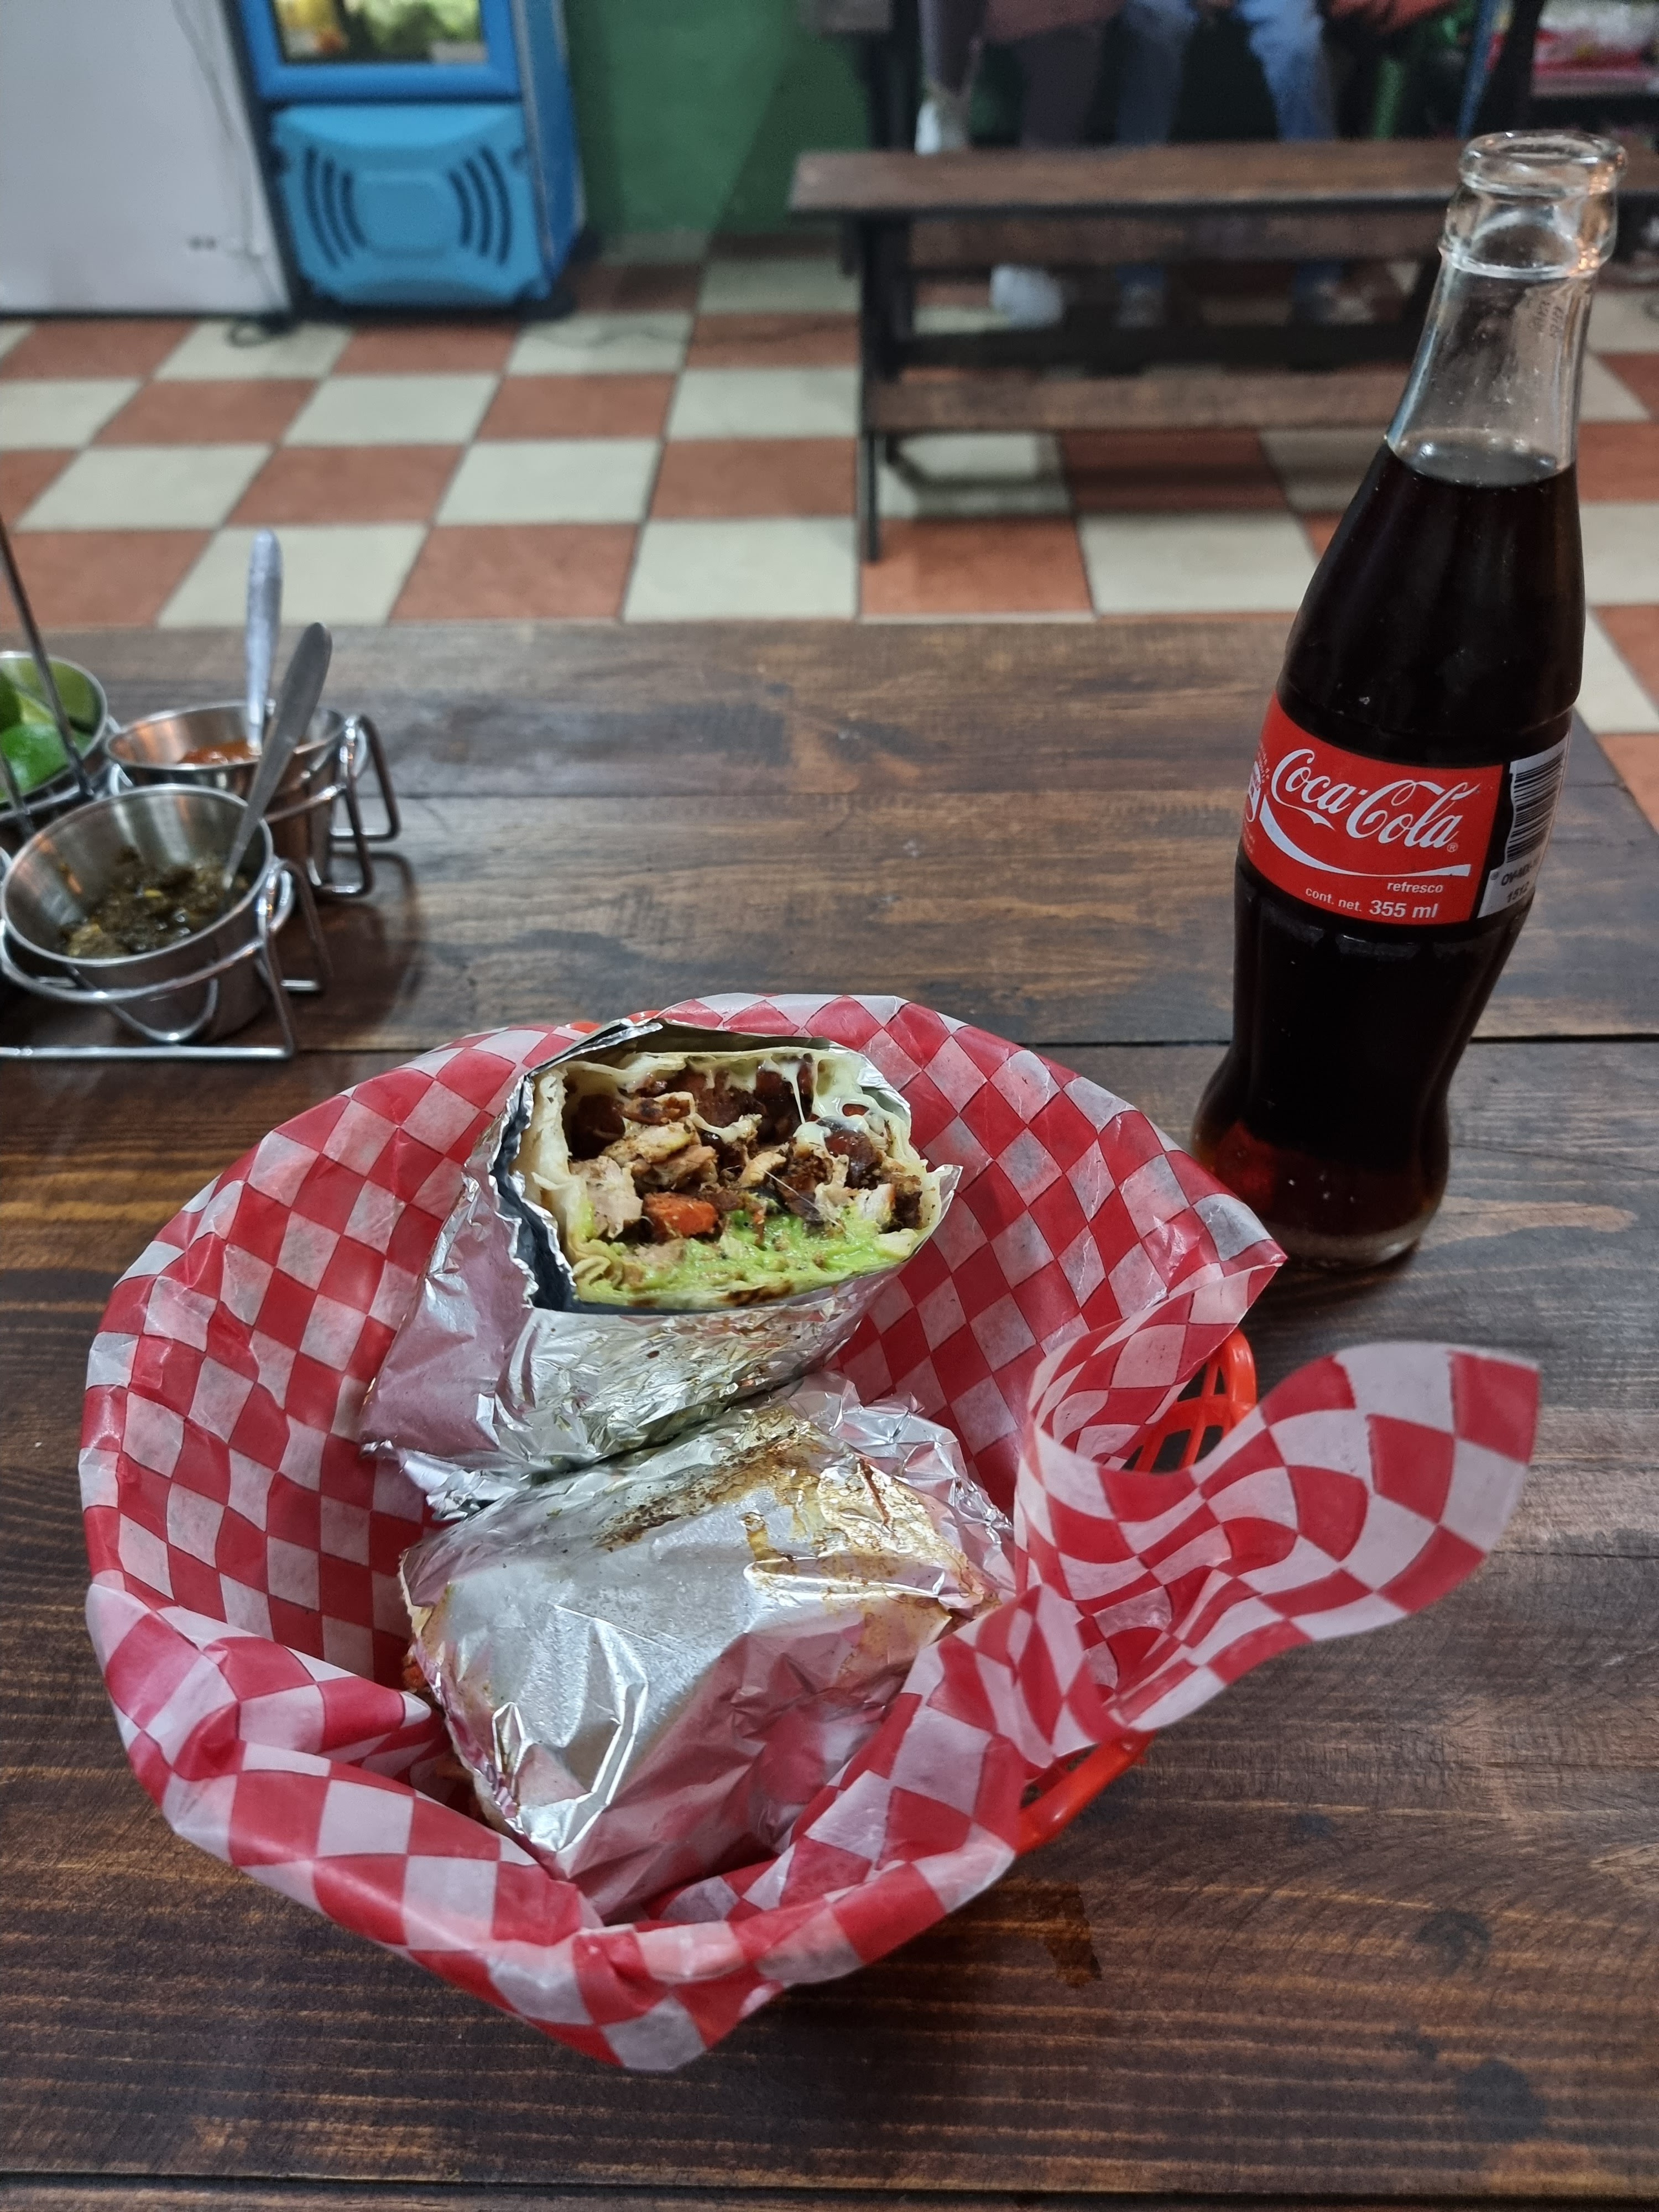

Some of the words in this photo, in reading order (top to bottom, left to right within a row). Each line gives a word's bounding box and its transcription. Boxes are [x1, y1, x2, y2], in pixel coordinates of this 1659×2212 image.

[1271, 748, 1481, 848] Coca-Cola
[1387, 881, 1444, 893] refresco
[1305, 888, 1334, 905] cont.
[1338, 899, 1362, 912] net.
[1369, 899, 1407, 918] 355
[1412, 903, 1438, 918] ml
